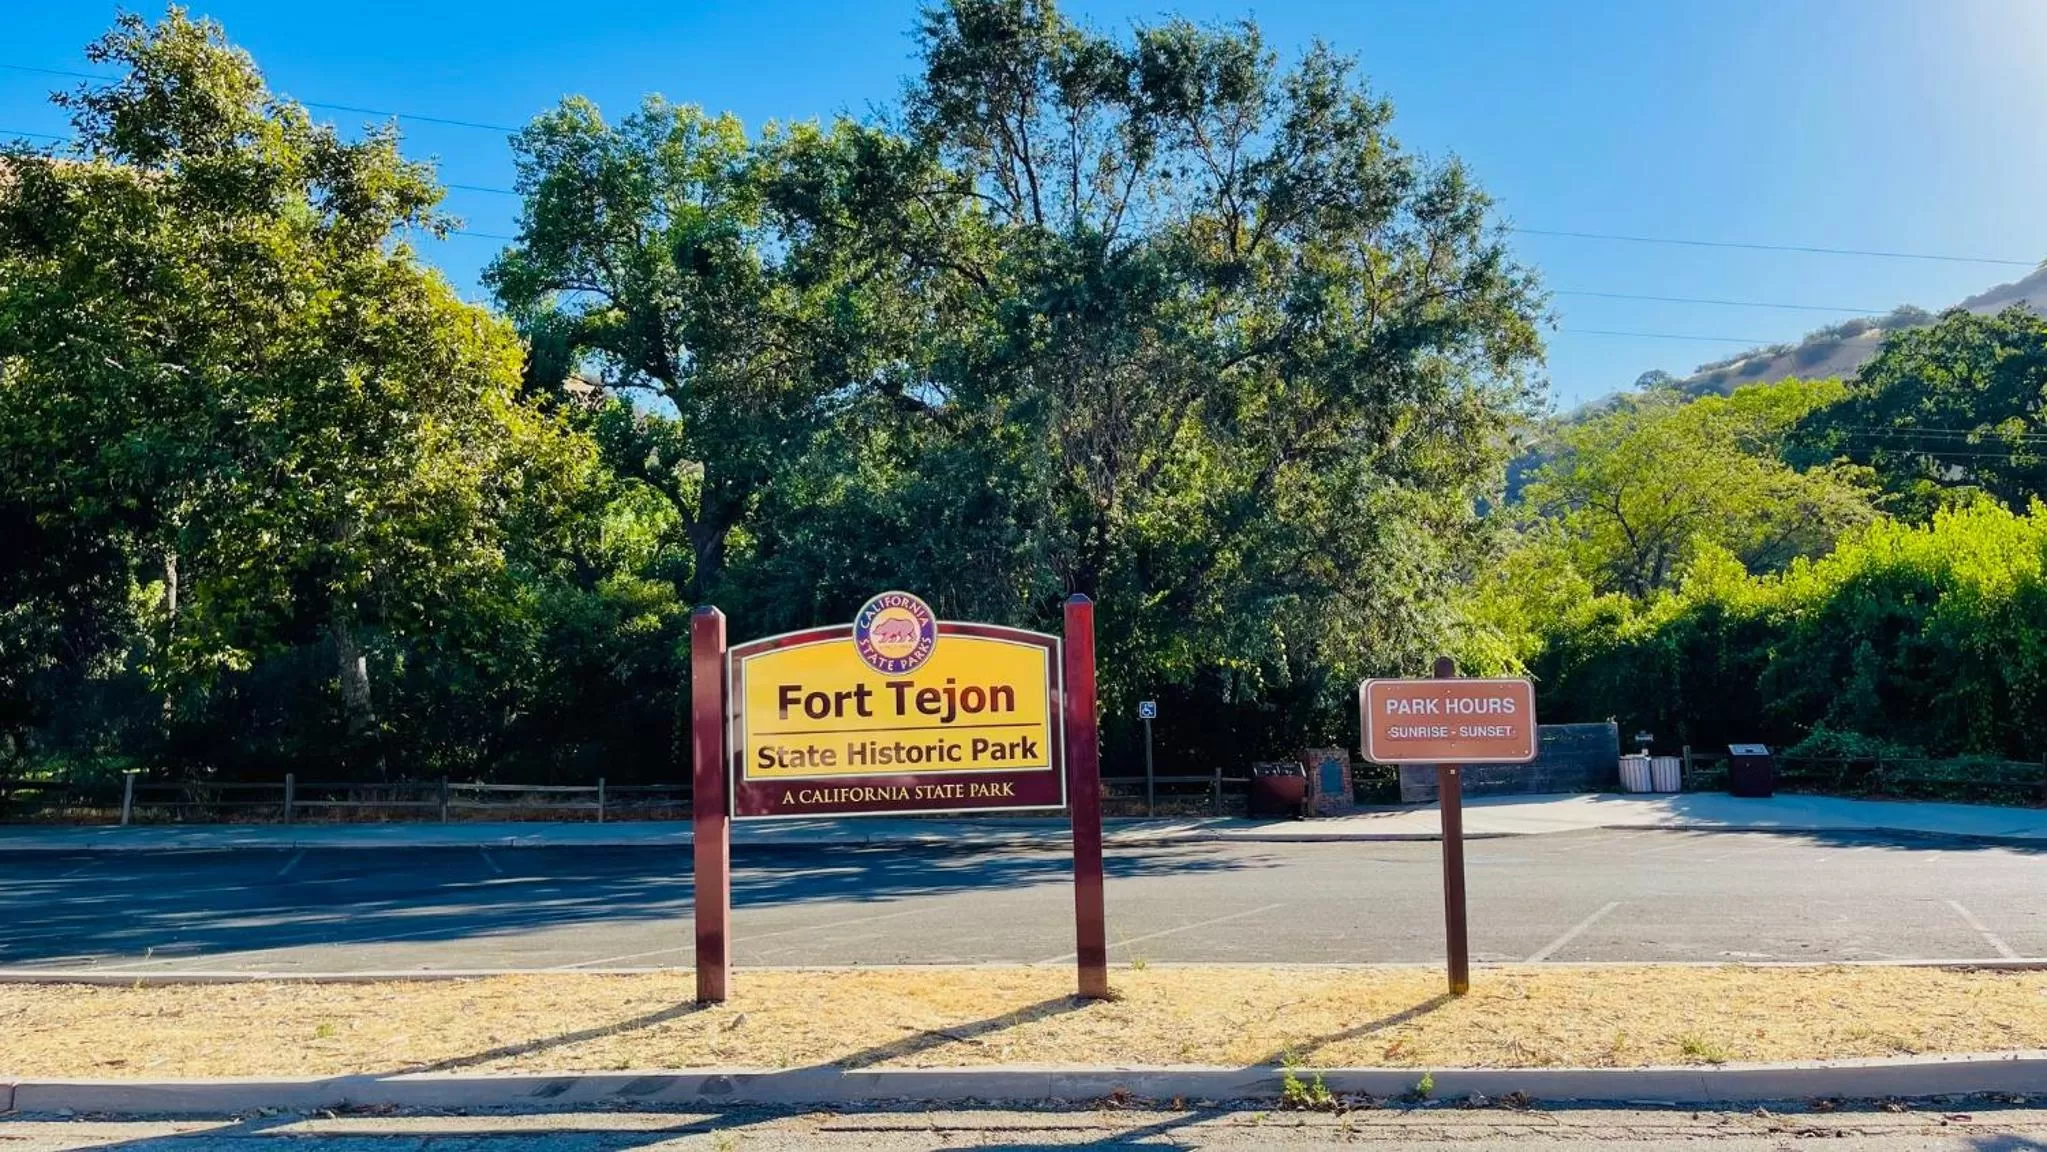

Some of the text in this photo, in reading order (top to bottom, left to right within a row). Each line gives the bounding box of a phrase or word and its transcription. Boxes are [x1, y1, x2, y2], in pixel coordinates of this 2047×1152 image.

[860, 596, 929, 629] CALIFORNIA
[860, 637, 932, 671] STATE PARKS
[778, 678, 1015, 723] Fort Tejon
[1386, 697, 1516, 715] PARK HOURS
[1390, 725, 1449, 738] SUNRISE
[1459, 724, 1513, 737] SUNSET
[757, 735, 1039, 769] State Historic Park
[782, 781, 1015, 805] A CALIFORNIA STATE PARK
